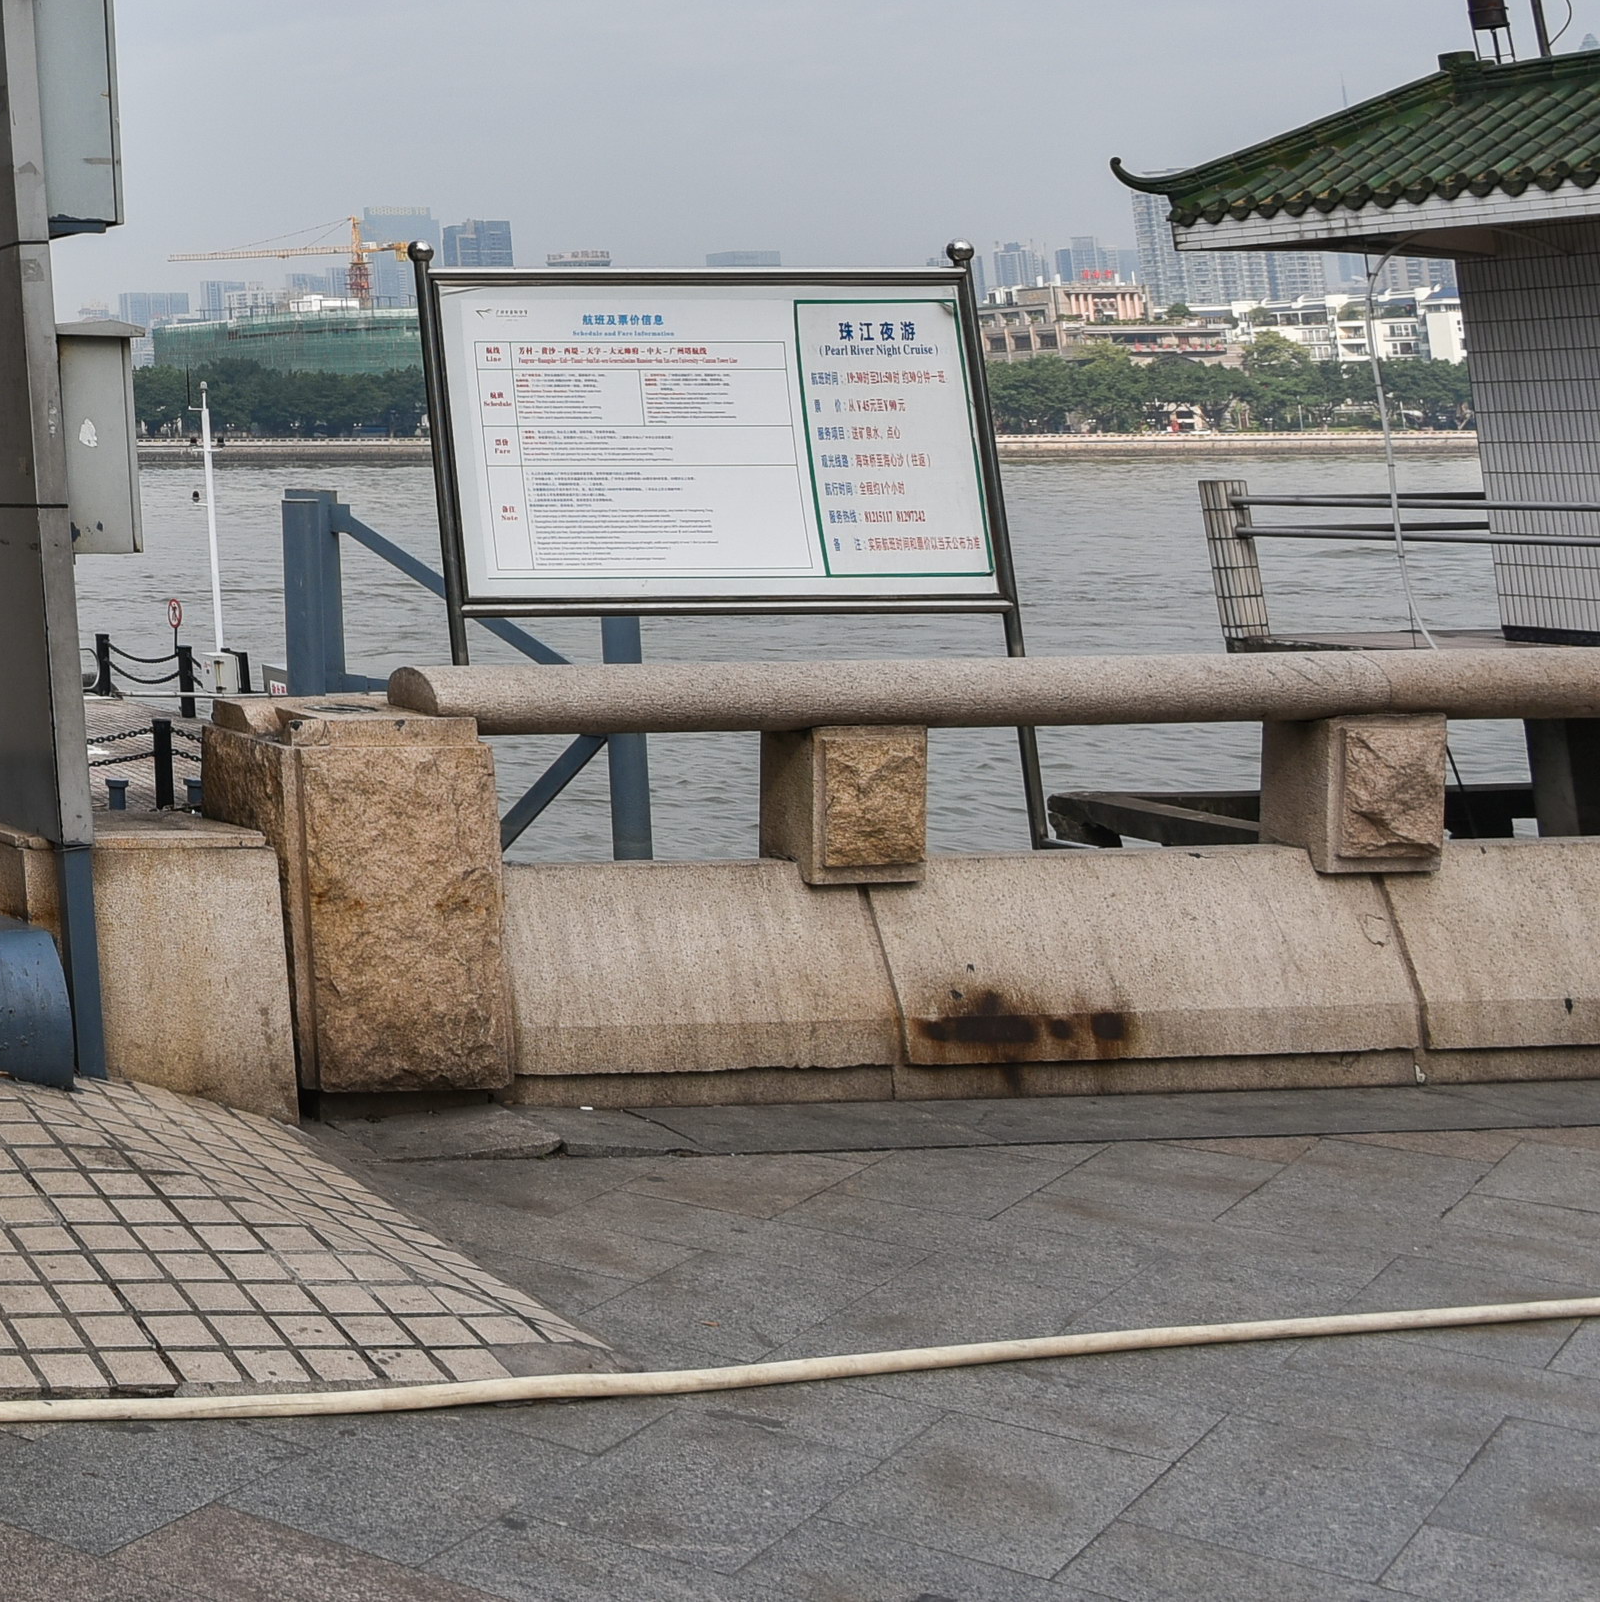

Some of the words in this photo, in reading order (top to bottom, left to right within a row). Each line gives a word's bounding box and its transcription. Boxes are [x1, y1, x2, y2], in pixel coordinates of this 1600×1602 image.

[583, 314, 664, 326] 航班及票价信息
[839, 321, 916, 342] 珠江夜游
[486, 347, 500, 355] 航线
[850, 345, 874, 356] River
[876, 344, 901, 357] Night
[490, 391, 504, 399] 航班
